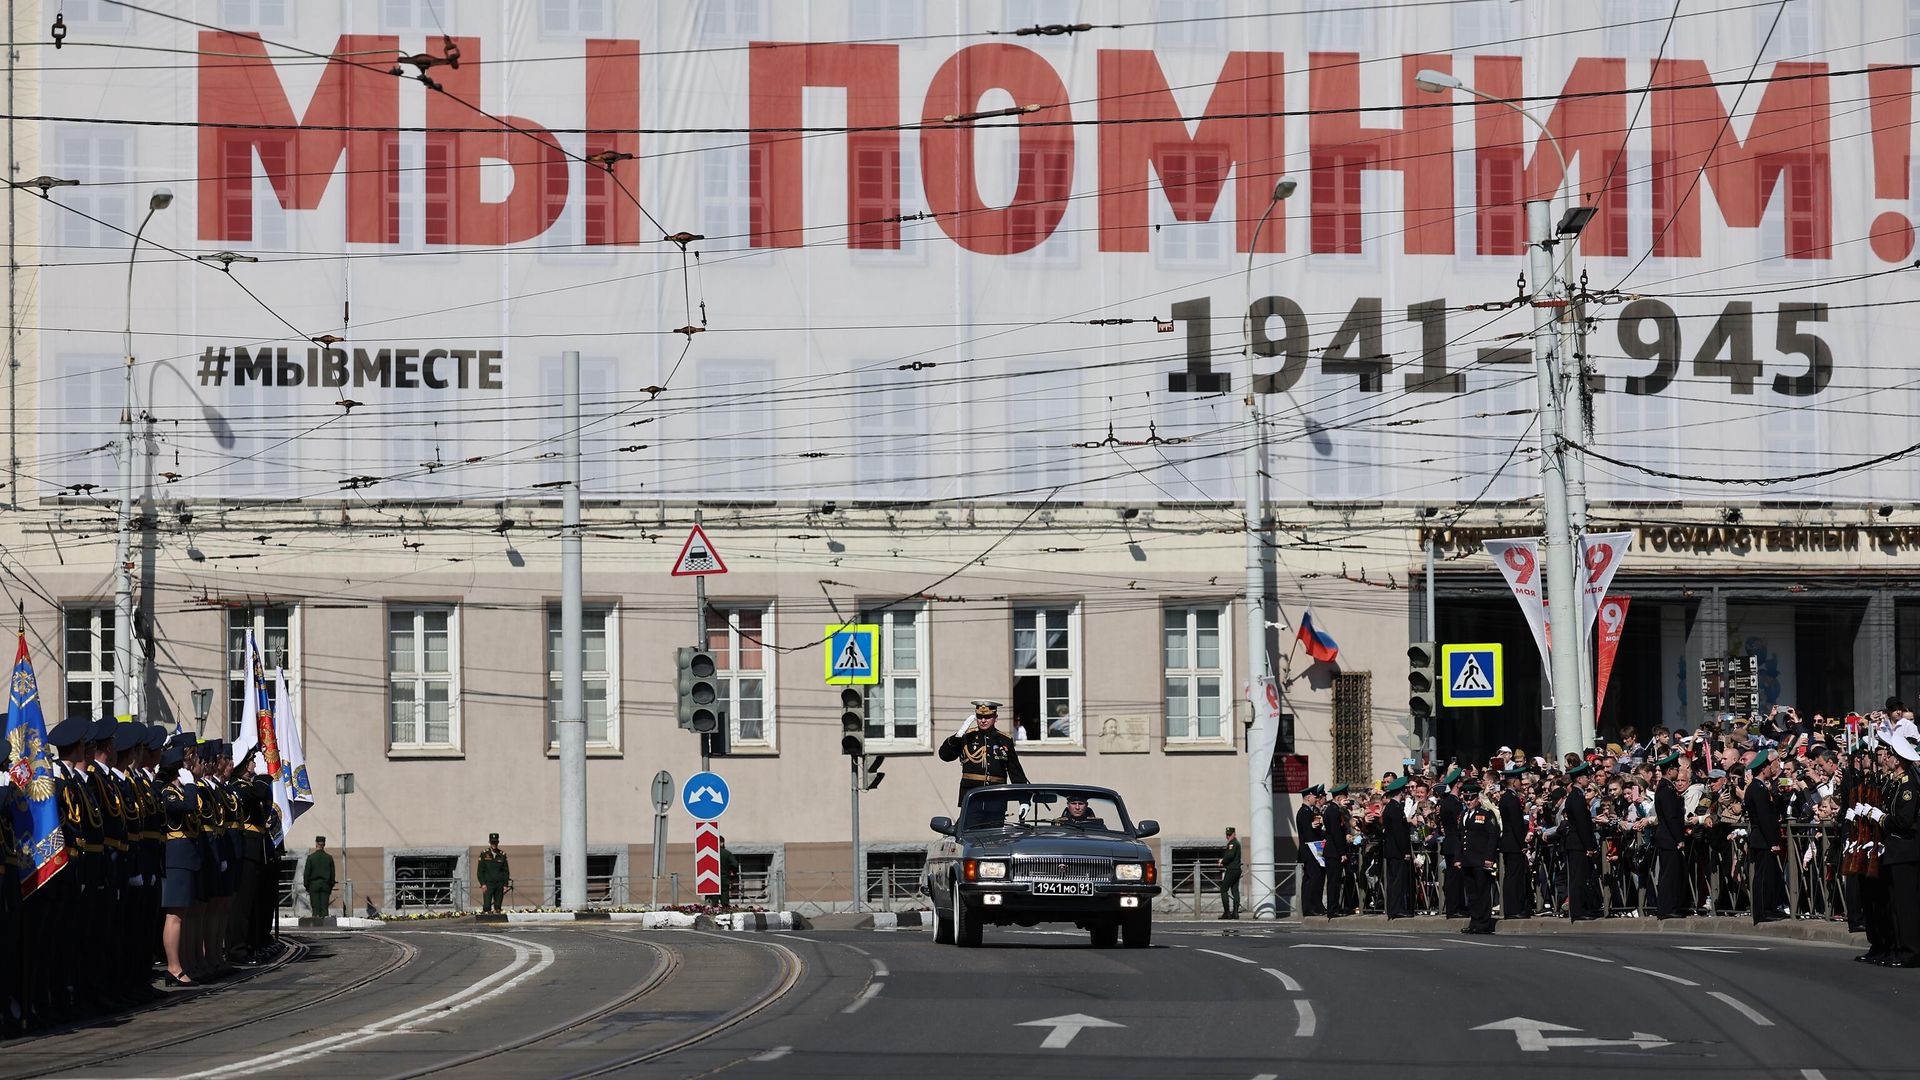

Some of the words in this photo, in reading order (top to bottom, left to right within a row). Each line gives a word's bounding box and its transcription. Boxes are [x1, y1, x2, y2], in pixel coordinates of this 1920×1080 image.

[197, 31, 641, 247] МЫ
[748, 41, 1916, 263] ПОМНИМ!
[1168, 296, 1835, 397] 1941–945
[198, 346, 504, 391] #МЫВМЕСТЕ
[1503, 547, 1535, 585] 9
[1584, 543, 1614, 584] 9
[1602, 602, 1622, 634] 9
[1037, 883, 1062, 893] 1941
